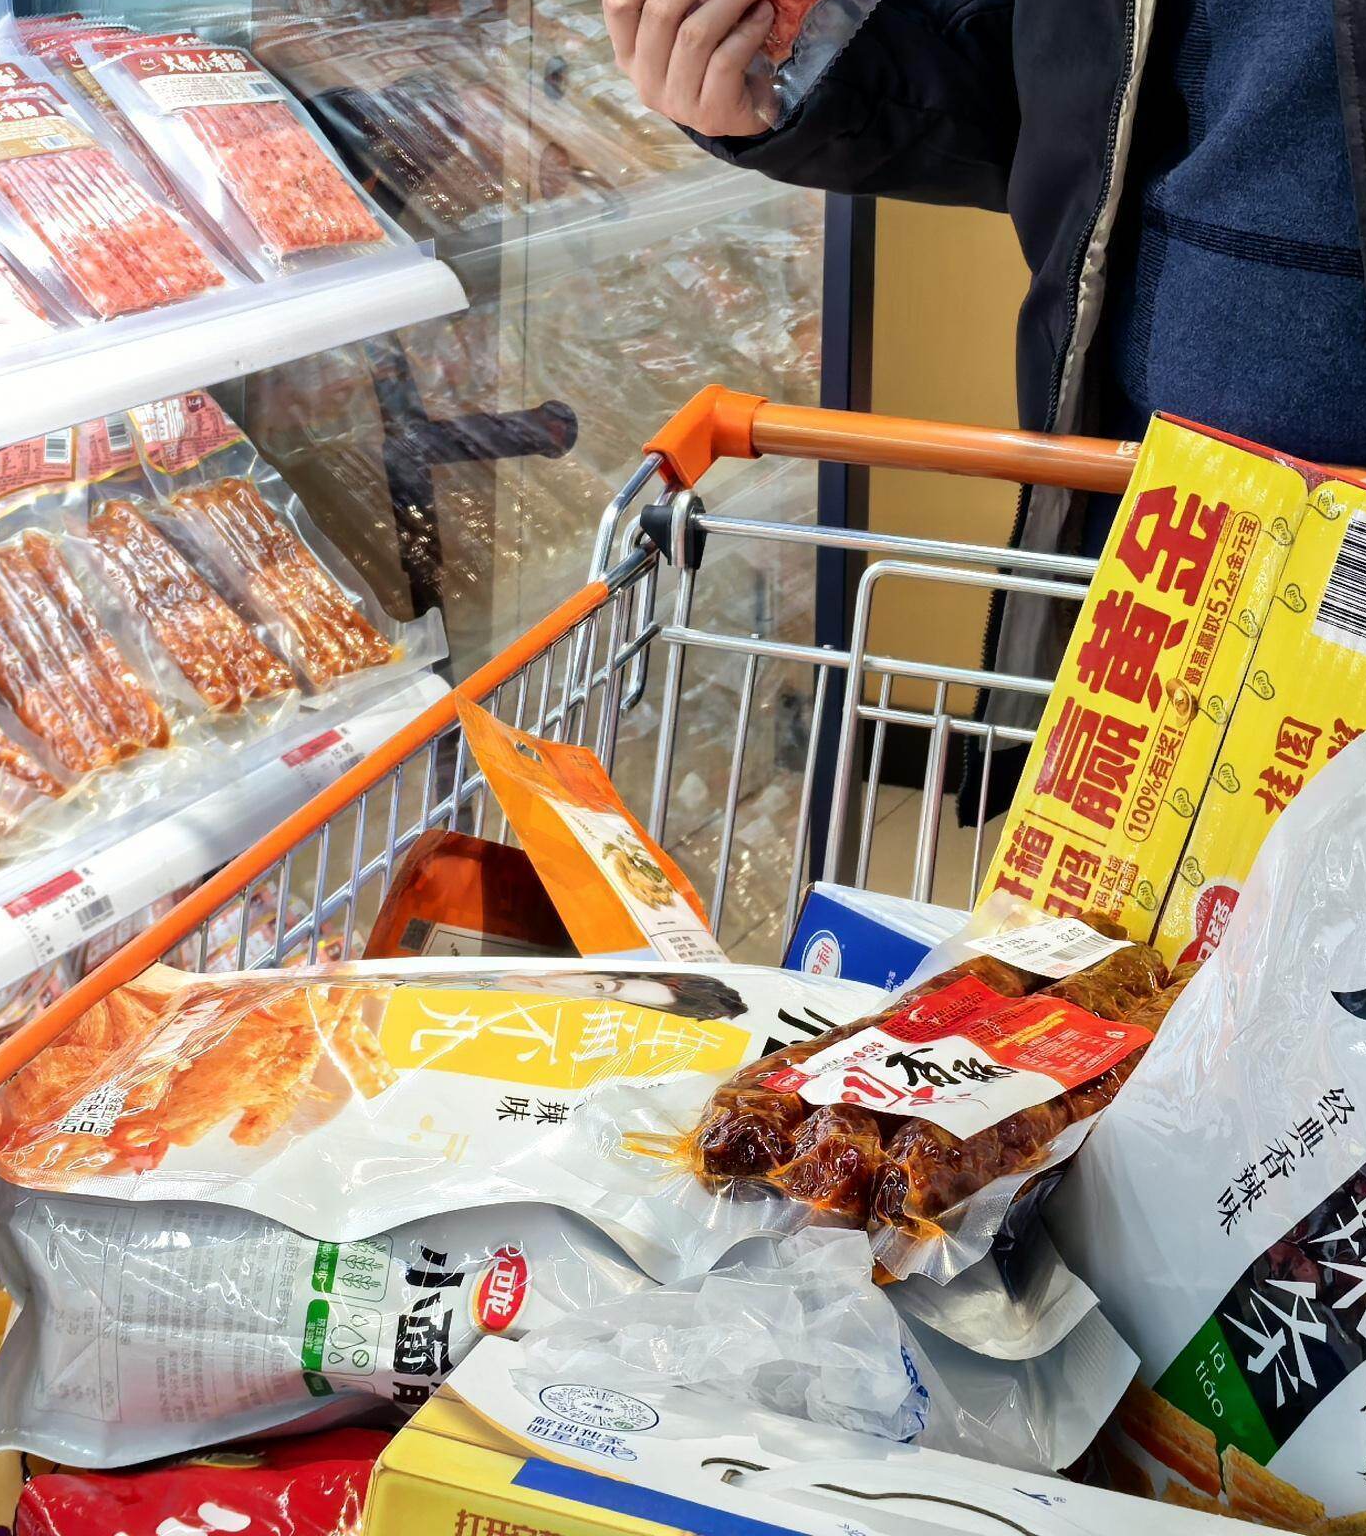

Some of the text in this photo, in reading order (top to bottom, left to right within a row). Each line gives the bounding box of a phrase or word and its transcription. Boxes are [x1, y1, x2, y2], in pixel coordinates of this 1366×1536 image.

[1034, 485, 1230, 831] 赢黄金
[1128, 725, 1185, 836] 100%有奖!
[65, 884, 97, 908] 21.90
[495, 1095, 571, 1126] 辣味
[1216, 1086, 1361, 1234] 经典香辣味
[481, 1258, 519, 1324] 卫龙
[1208, 1341, 1226, 1373] là
